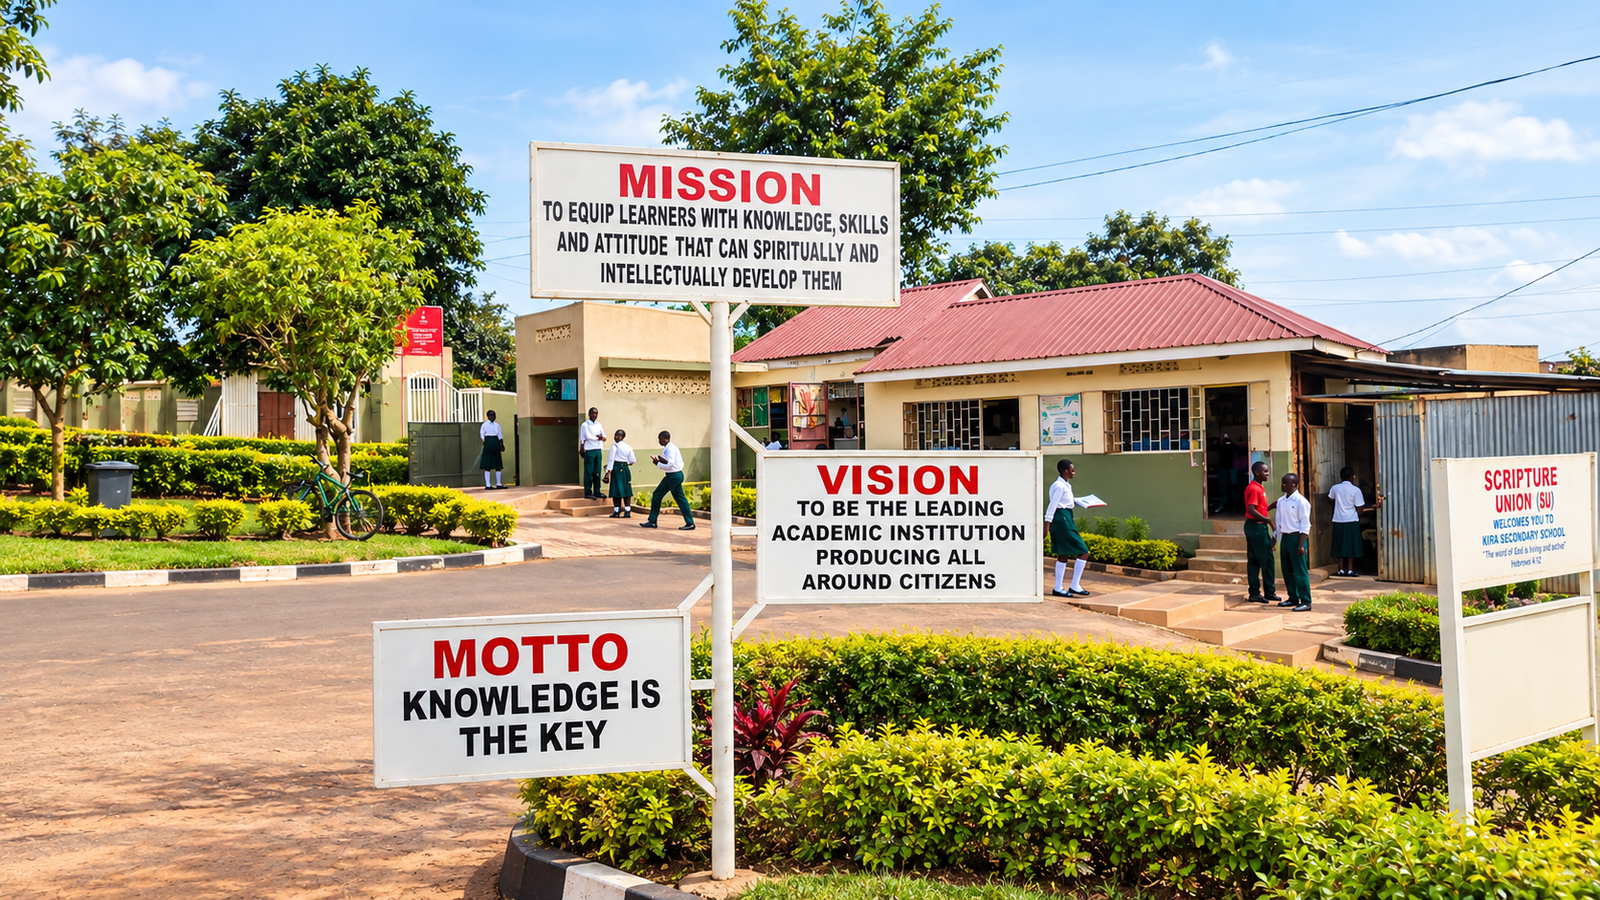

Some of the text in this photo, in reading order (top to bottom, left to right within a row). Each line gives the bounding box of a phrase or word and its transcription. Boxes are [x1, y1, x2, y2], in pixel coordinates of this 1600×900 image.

[620, 164, 820, 206] MISSION
[543, 201, 888, 237] TO EQUIP LEARNERS WITH KNOWLEDGE, SKILLS
[557, 232, 878, 262] AND ATTITUDE THAT CAN SPIRITUALLY AND
[601, 263, 841, 290] INTELLECTUALLY DEVELOP THEM
[817, 465, 978, 495] VISION
[1484, 467, 1558, 491] SCRIPTURE
[797, 501, 1003, 516] TO BE THE LEADING
[1495, 491, 1554, 513] UNION (SU)
[772, 525, 1025, 541] ACADEMIC INSTITUTION
[1493, 514, 1554, 529] WELCOMES YOU TO
[1482, 527, 1565, 546] KIRA SECONDARY SCHOOL
[817, 549, 985, 565] PRODUCING ALL
[802, 574, 996, 590] AROUND CITIZENS
[434, 633, 628, 679] MOTTO
[403, 679, 660, 721] KNOWLEDGE IS
[459, 720, 607, 757] THE KEY
